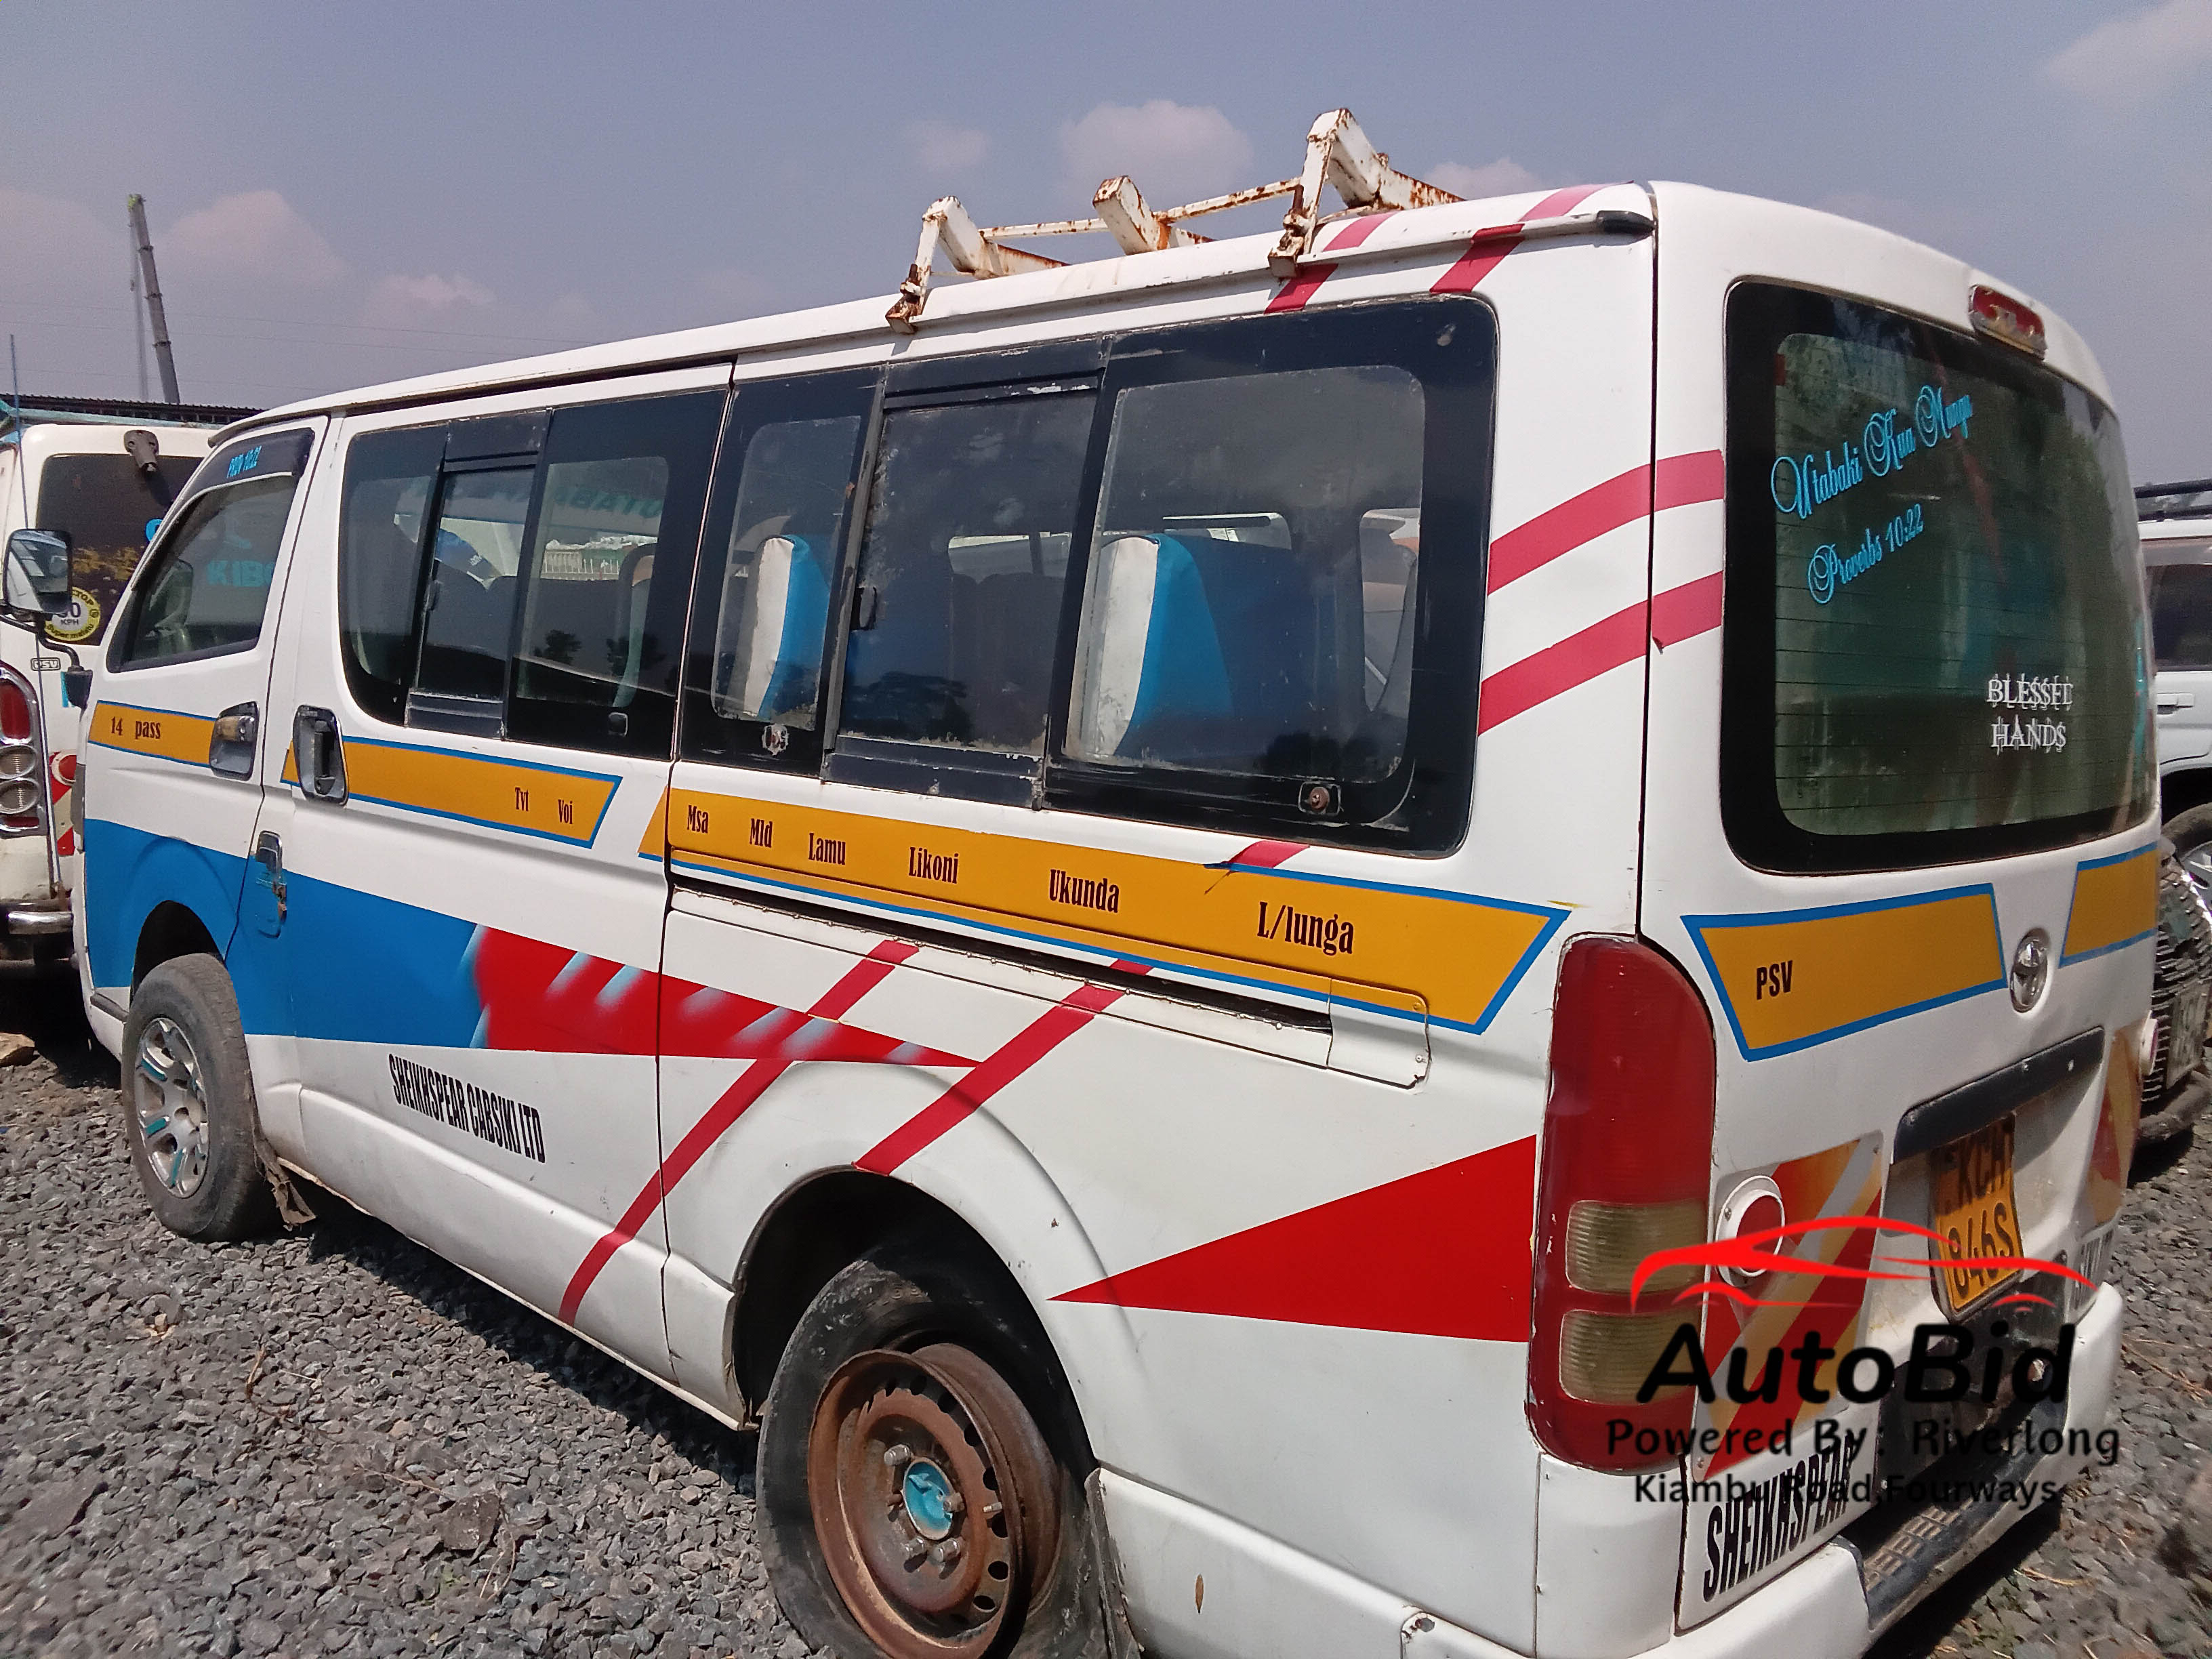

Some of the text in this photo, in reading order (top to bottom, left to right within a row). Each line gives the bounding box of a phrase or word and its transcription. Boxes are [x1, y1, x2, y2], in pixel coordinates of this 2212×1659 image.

[1808, 504, 1923, 604] Proverbs 10:22
[111, 716, 161, 740] 14 pass
[1991, 714, 2066, 756] HANDS
[558, 799, 573, 824] Voi
[687, 804, 709, 834] Msa
[808, 832, 846, 865] Lamu
[908, 846, 960, 884] Likoni
[1048, 868, 1120, 913] Ukunda
[1257, 901, 1354, 956] L/lunga
[1756, 960, 1793, 1000] PSV
[388, 1054, 469, 1132] SHEIKHSPEAR
[518, 1103, 546, 1164] LTD
